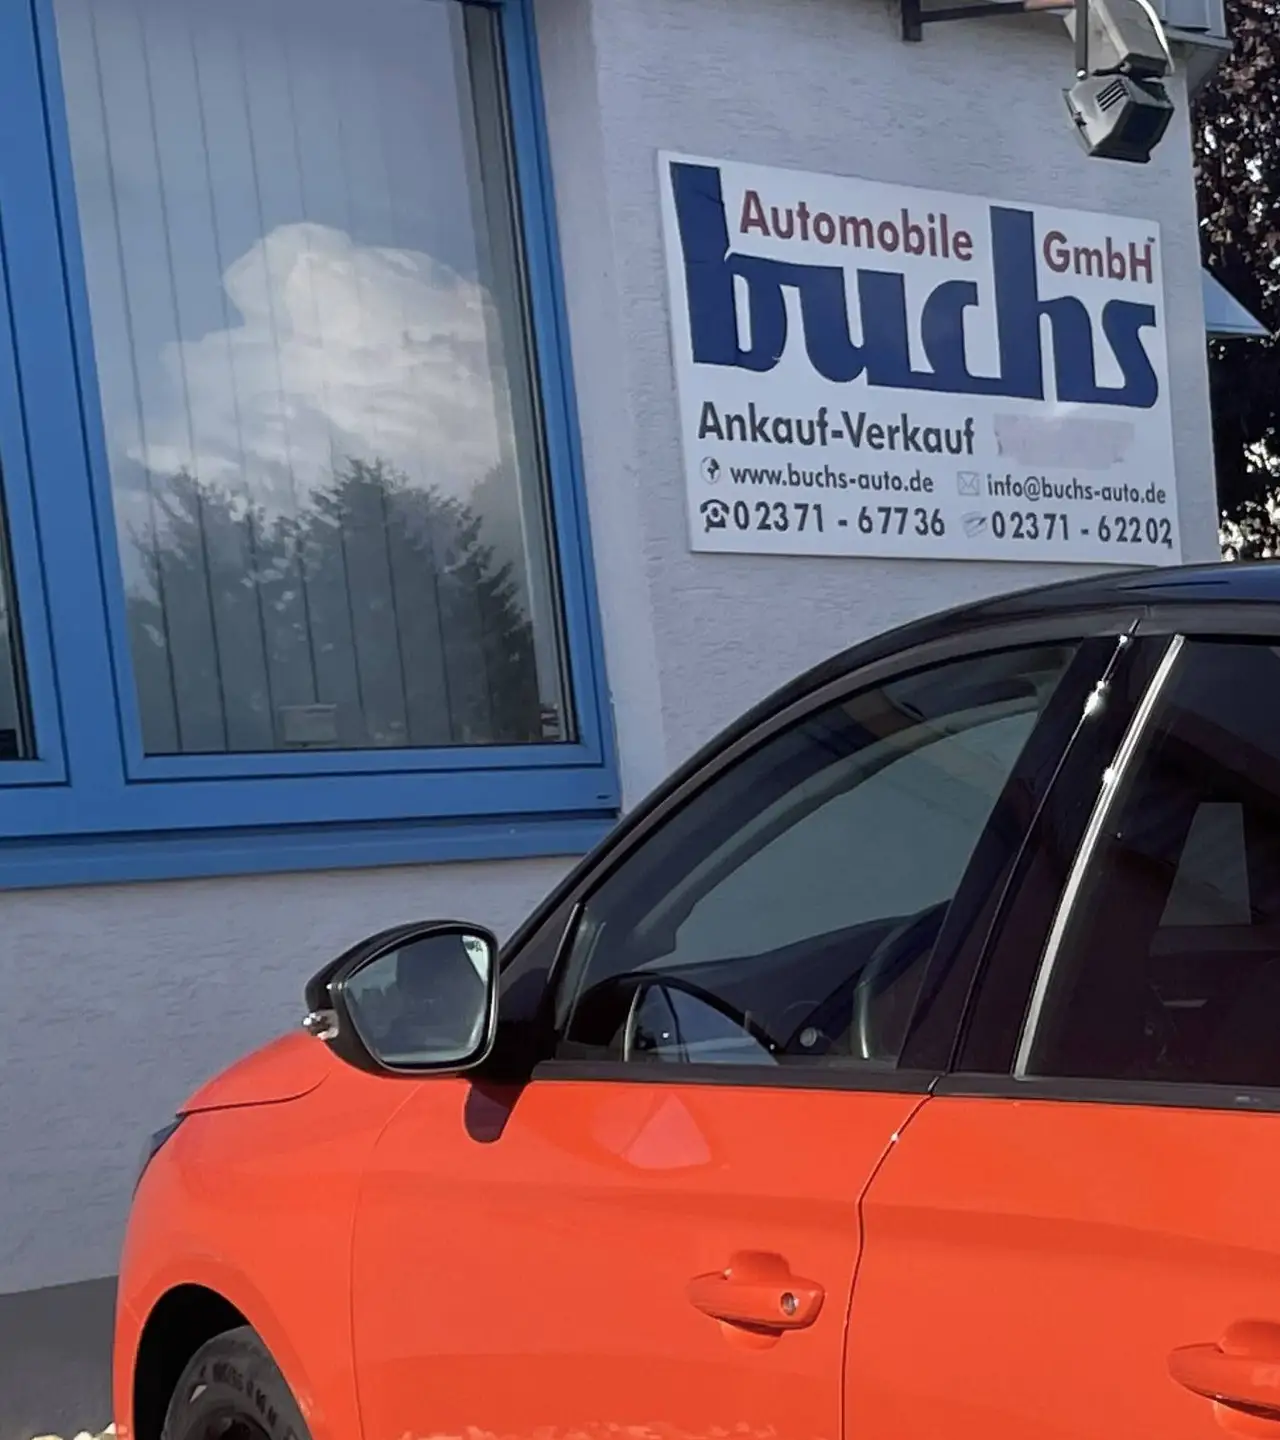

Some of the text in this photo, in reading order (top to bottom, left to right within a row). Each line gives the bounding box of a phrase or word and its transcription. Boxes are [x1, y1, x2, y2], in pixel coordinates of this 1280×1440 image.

[740, 190, 1154, 284] Automobile GmbH
[669, 160, 1159, 409] buchs
[697, 400, 976, 456] Ankauf-Verkauf
[729, 462, 934, 493] www.buchs-auto.de
[986, 473, 1167, 504] info@buchs-auto.de
[733, 500, 825, 533] 02371
[858, 505, 946, 537] 67736
[991, 510, 1070, 541] 02371
[1097, 515, 1173, 547] 62202
